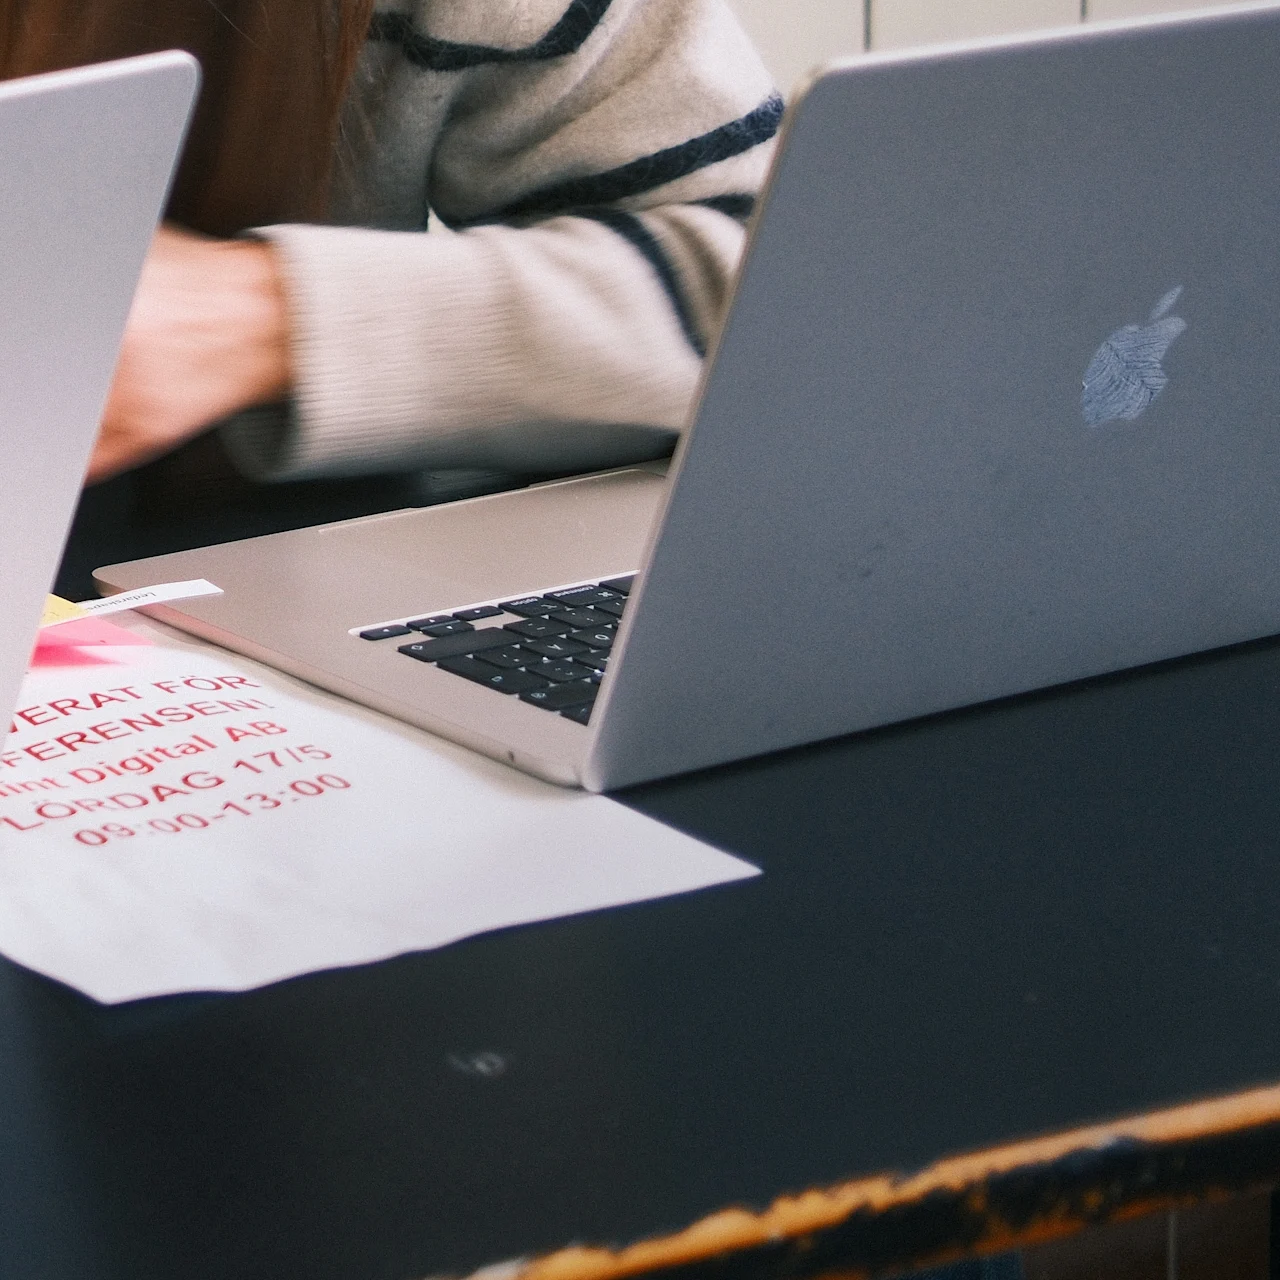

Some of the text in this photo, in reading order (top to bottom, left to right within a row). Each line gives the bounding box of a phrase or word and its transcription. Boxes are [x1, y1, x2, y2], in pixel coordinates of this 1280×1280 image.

[9, 675, 261, 734] ERAT FÖR
[68, 734, 220, 784] Digital
[223, 720, 289, 743] AB
[2, 744, 333, 831] LÖRDAG 17/5
[73, 773, 352, 847] 09:00-13:00
